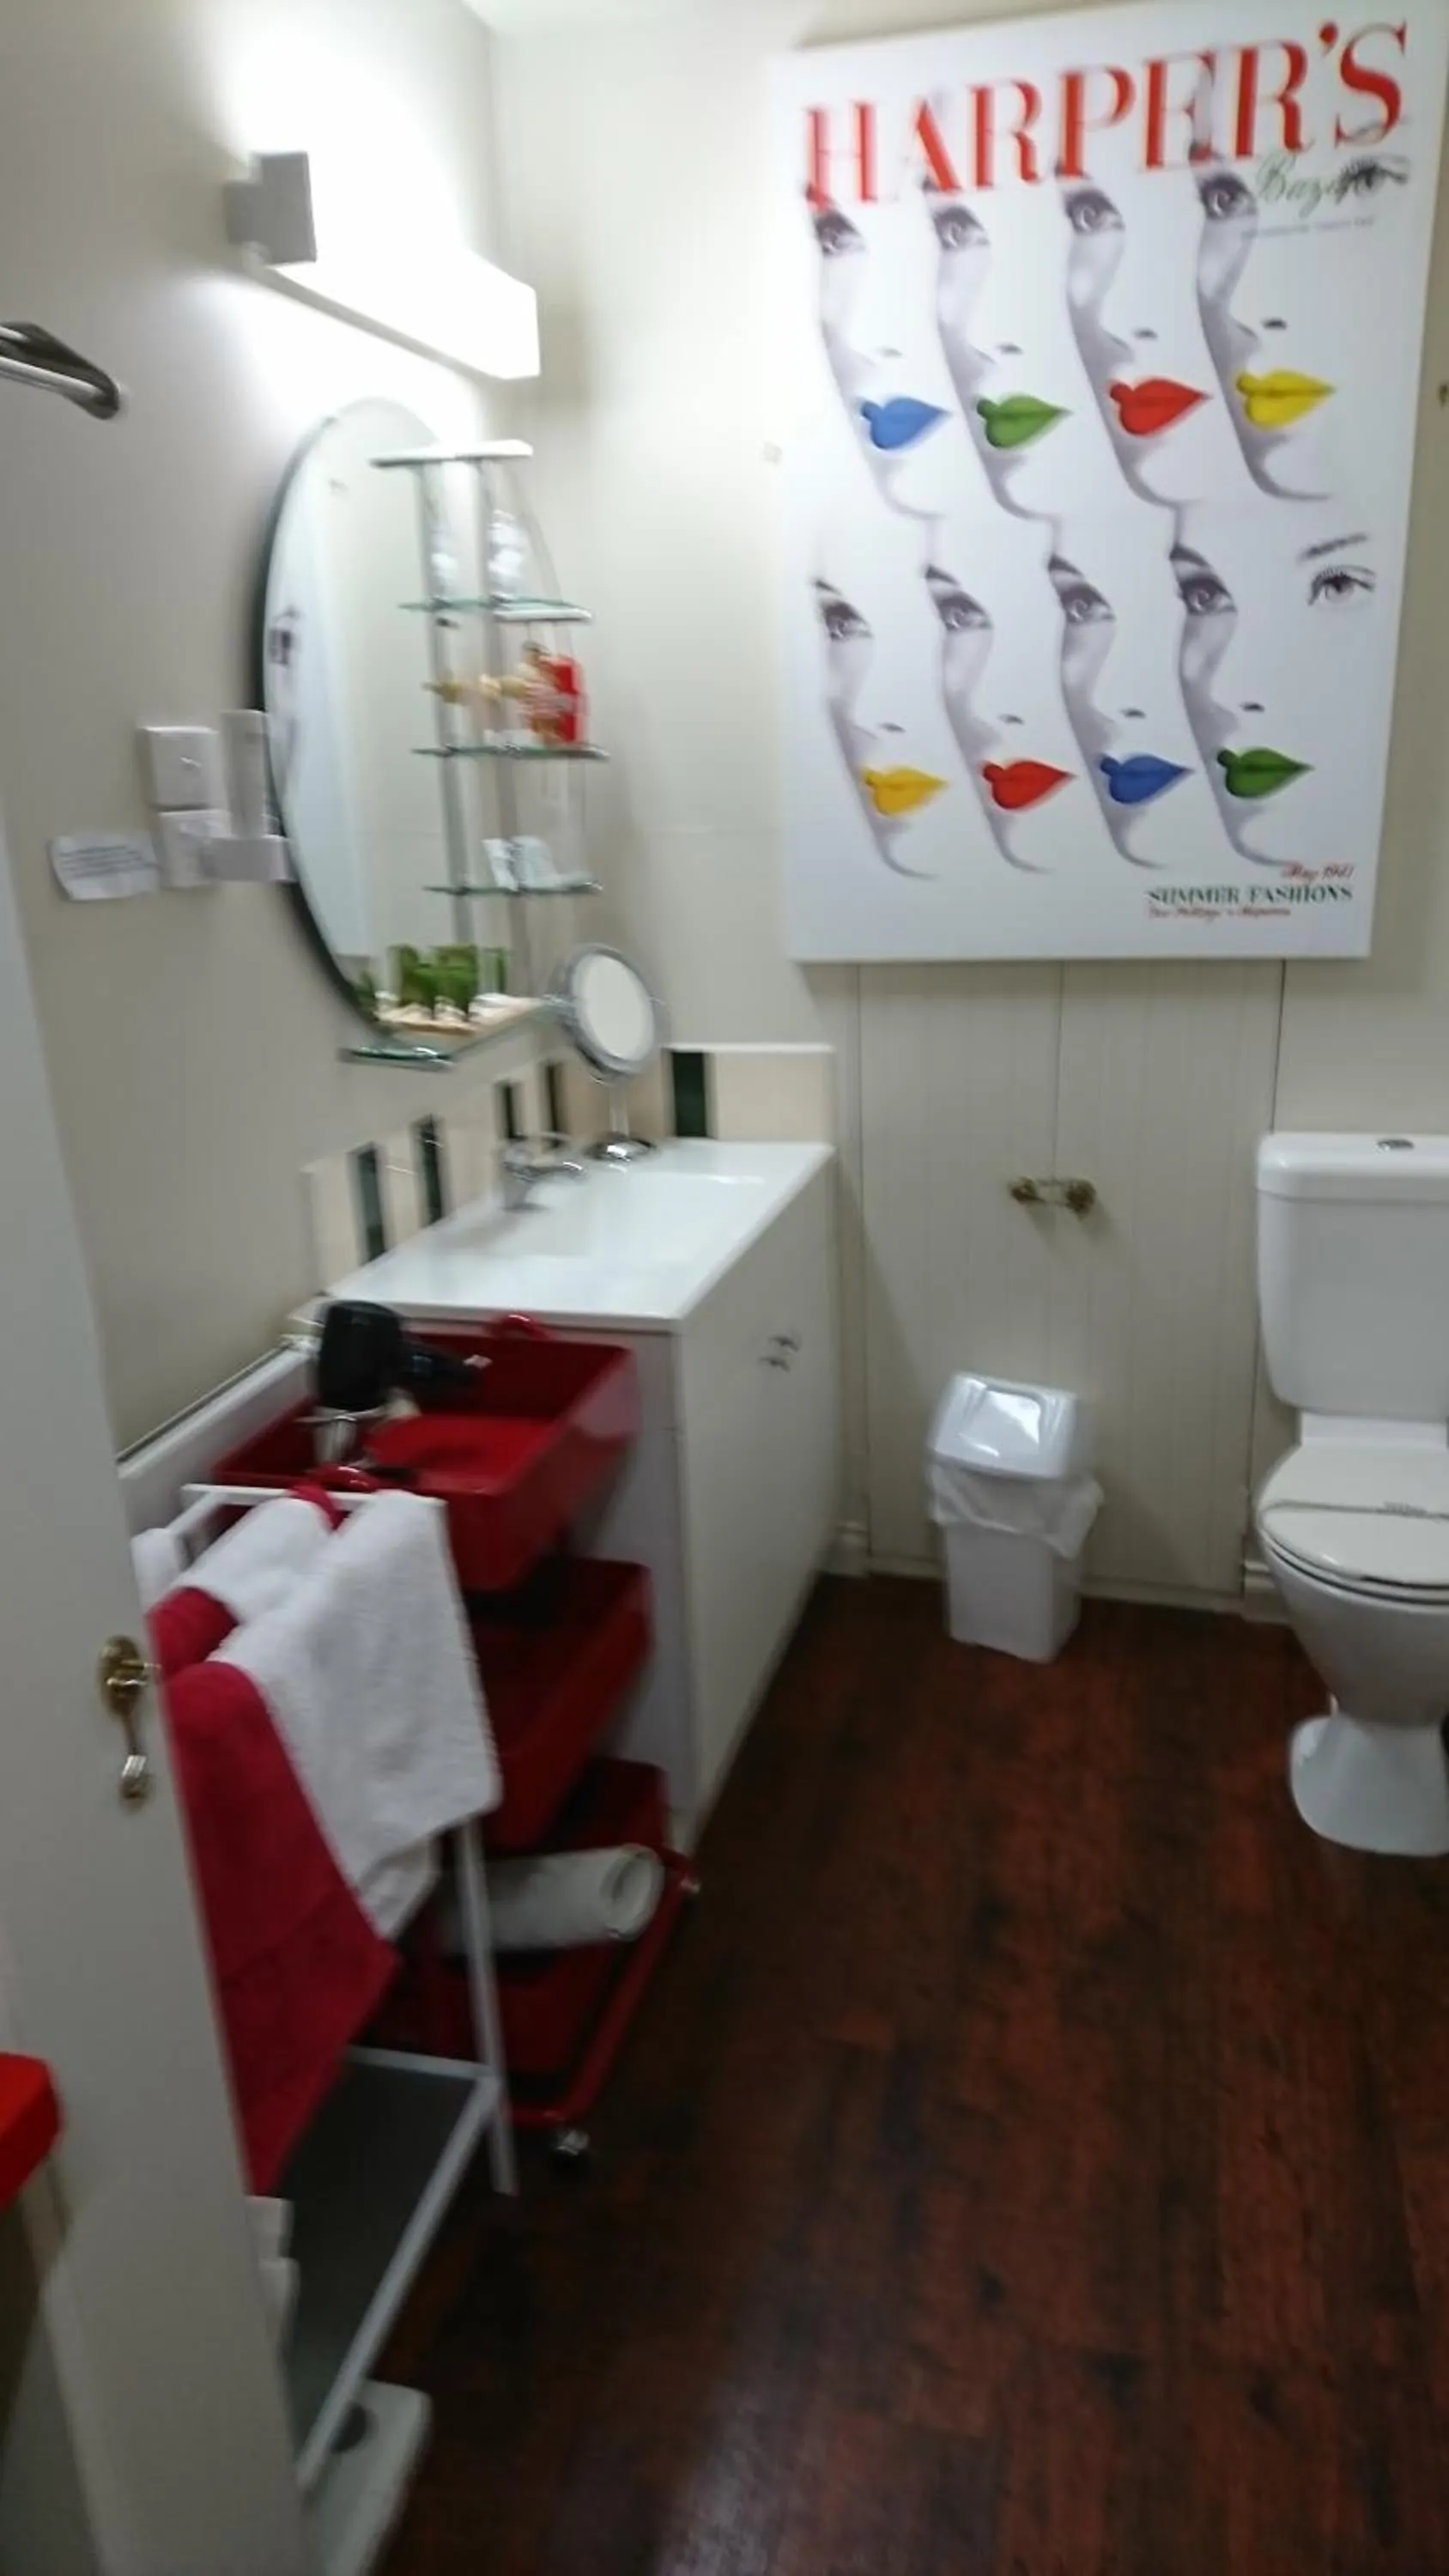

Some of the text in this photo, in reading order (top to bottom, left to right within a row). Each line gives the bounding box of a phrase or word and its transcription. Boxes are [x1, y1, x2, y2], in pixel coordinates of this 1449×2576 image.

[800, 21, 1408, 211] HARPER'S
[1146, 884, 1354, 905] SUMMER FASHIONS
